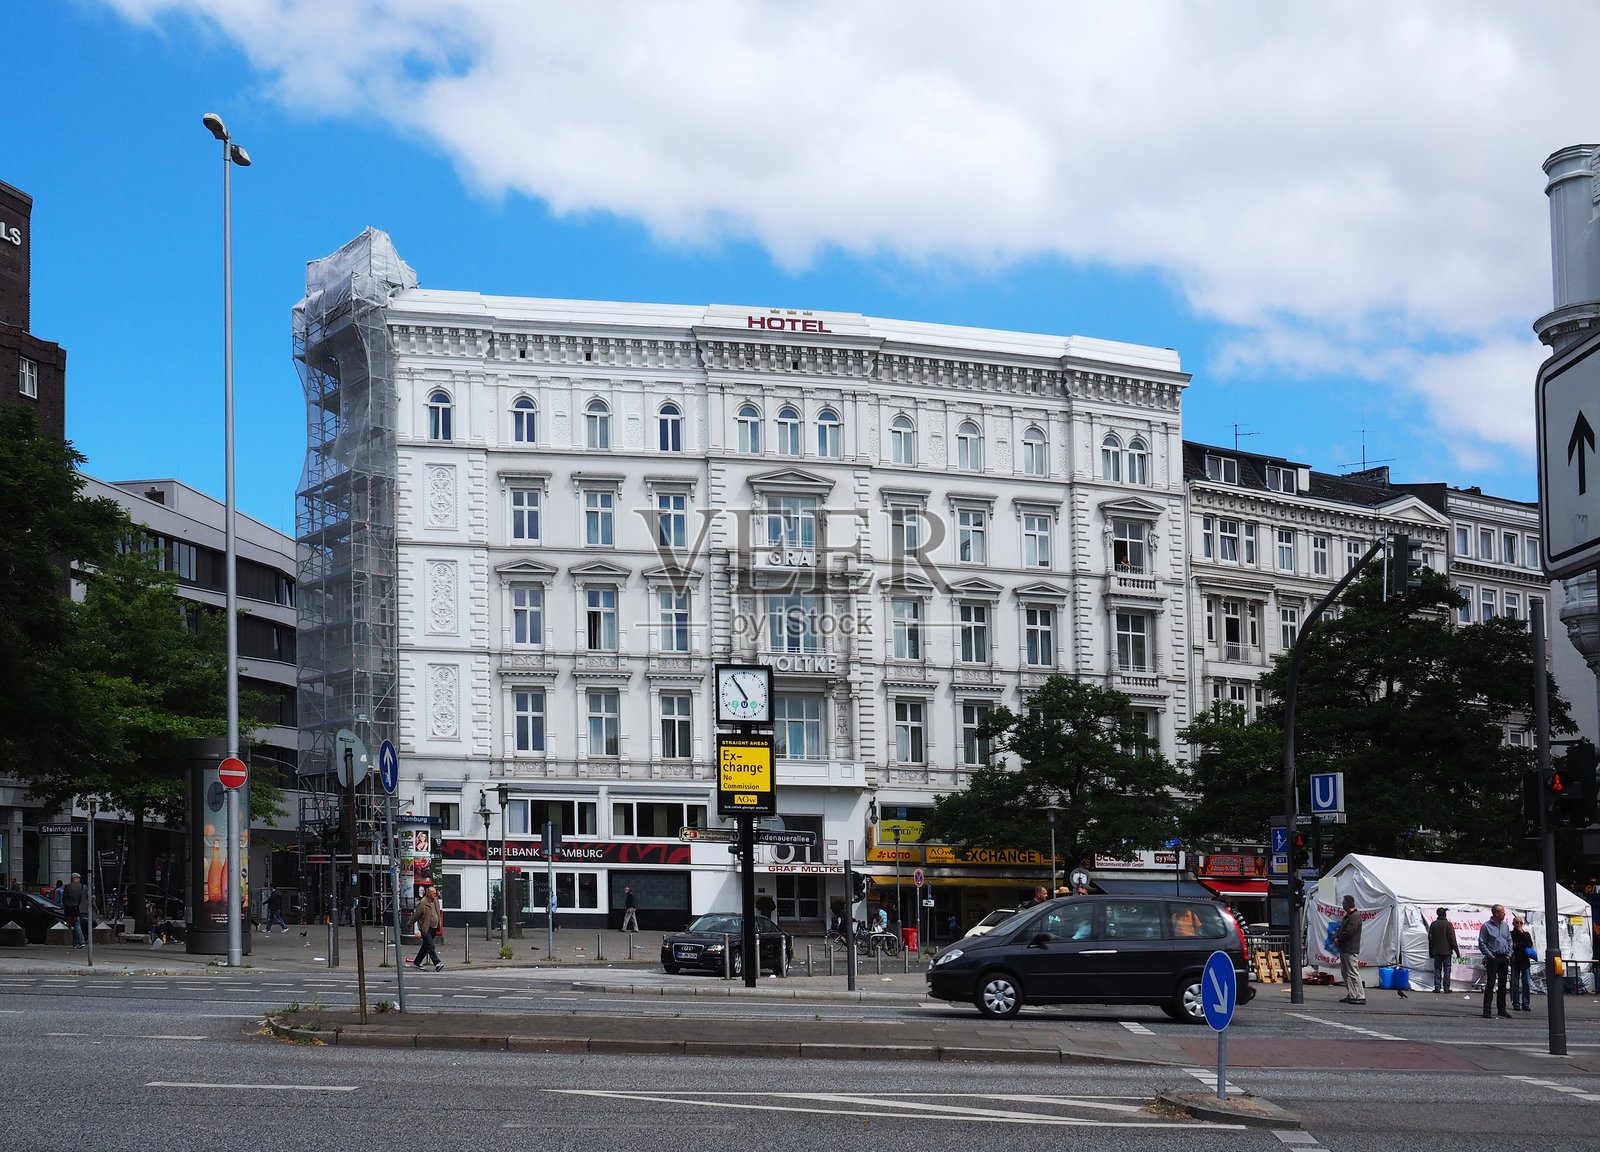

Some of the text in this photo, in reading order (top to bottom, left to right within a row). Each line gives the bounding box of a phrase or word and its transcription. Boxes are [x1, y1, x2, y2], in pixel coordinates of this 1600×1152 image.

[747, 316, 832, 333] HOTEL
[768, 549, 821, 566] GRAF
[760, 656, 837, 673] MOLTKE
[723, 750, 743, 761] Ex-
[723, 761, 763, 776] change
[723, 782, 760, 790] Commission
[1315, 777, 1334, 808] U
[41, 825, 84, 835] Steintorplatz
[759, 833, 811, 843] Adenauerallee
[487, 847, 604, 858] SPIELBANK AMBURG
